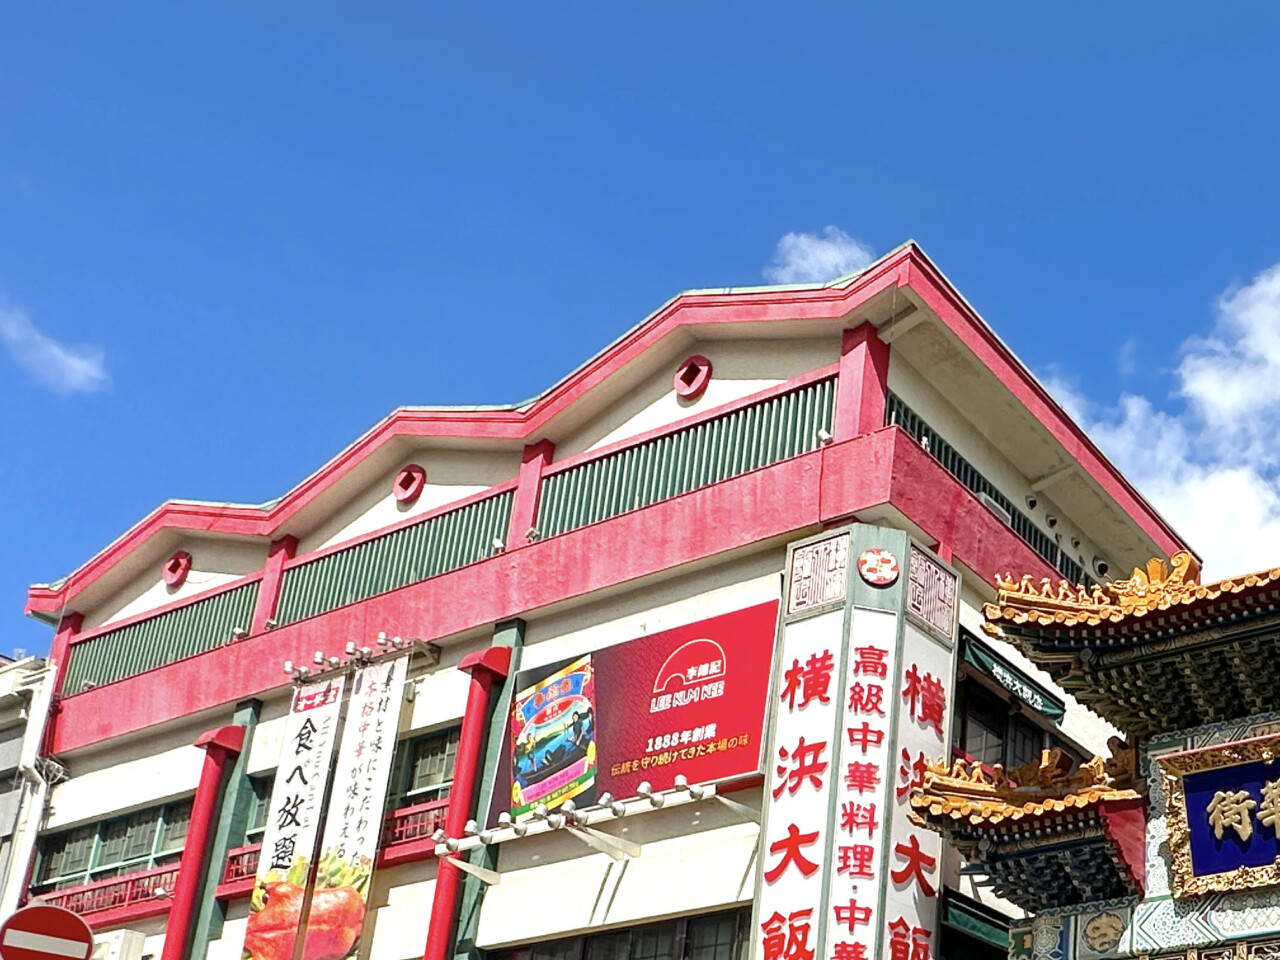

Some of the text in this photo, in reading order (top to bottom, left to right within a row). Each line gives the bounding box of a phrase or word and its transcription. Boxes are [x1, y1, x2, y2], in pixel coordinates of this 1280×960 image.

[650, 680, 725, 713] LEE KUM KEE
[610, 733, 751, 777] 伝統を守り続けてきた本場の味
[645, 723, 718, 753] 1888年創業
[270, 718, 318, 871] 食べ放題
